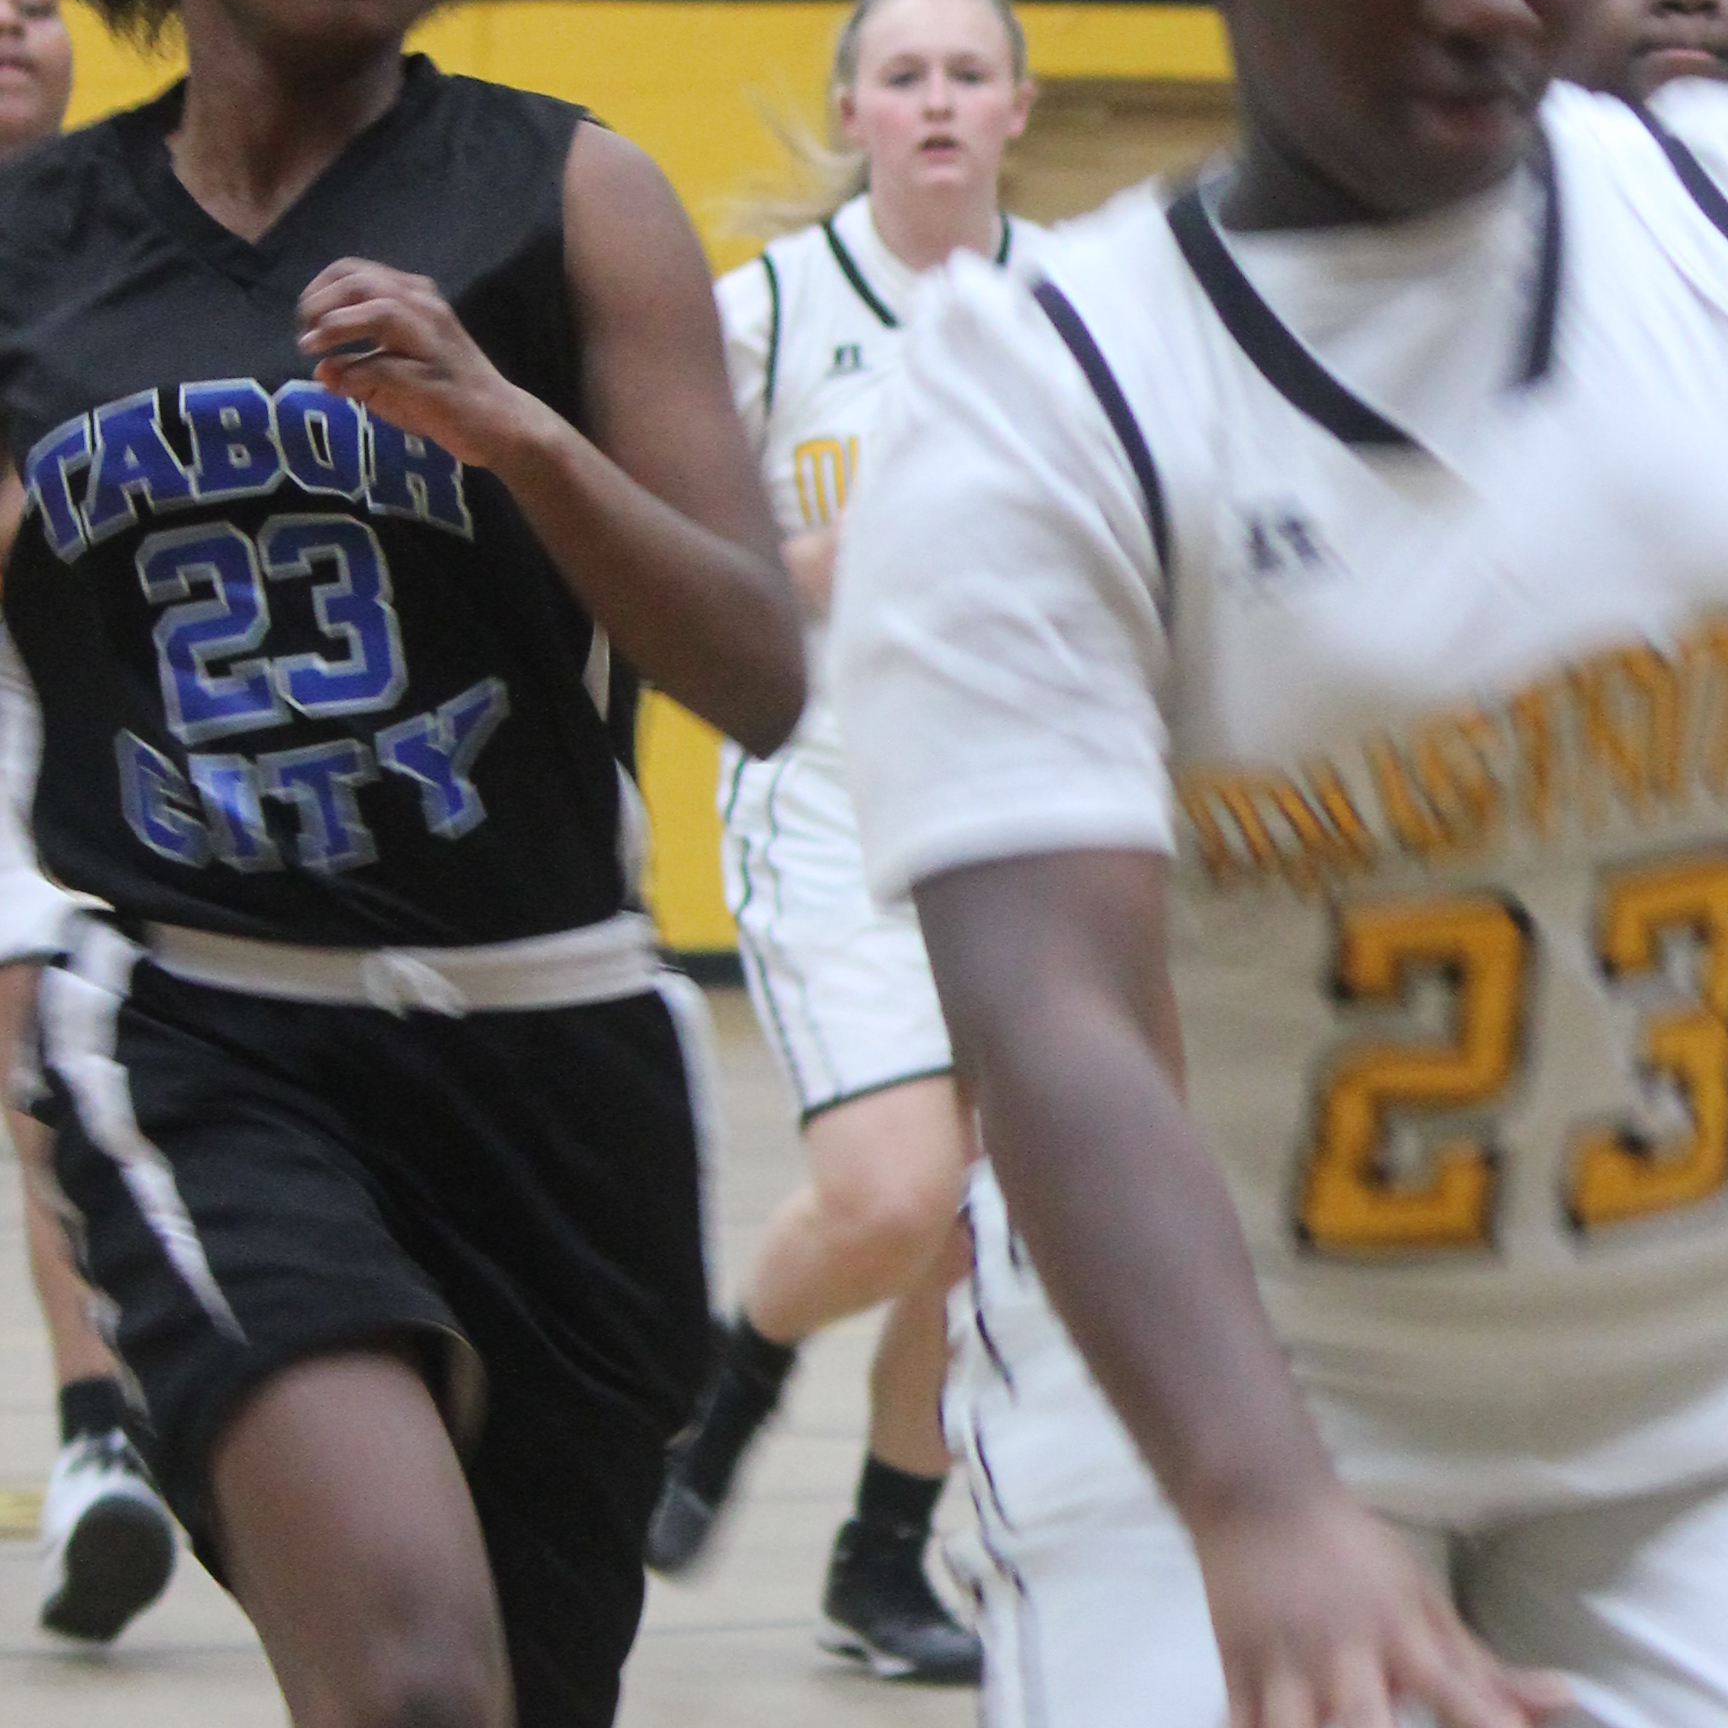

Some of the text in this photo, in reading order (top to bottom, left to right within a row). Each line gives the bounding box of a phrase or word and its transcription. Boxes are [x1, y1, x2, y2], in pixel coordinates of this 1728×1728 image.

[22, 376, 476, 566] TABOR
[134, 512, 409, 746] 23
[113, 675, 511, 874] CITY
